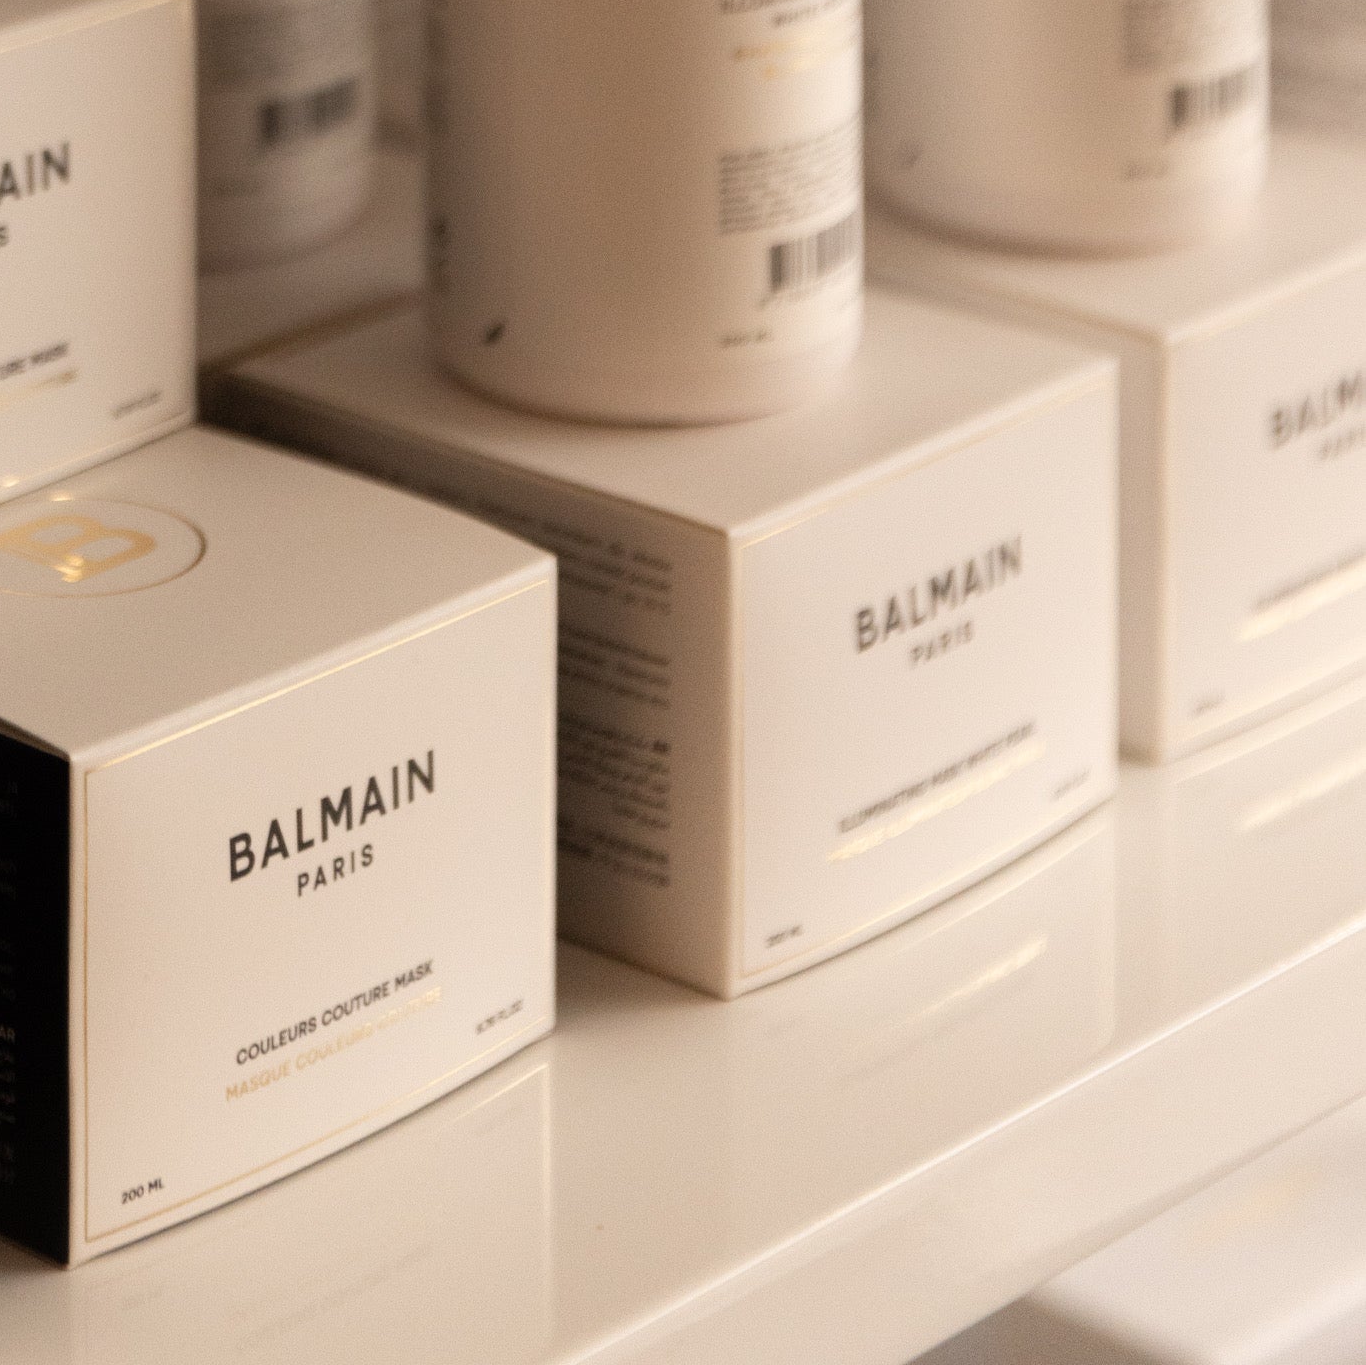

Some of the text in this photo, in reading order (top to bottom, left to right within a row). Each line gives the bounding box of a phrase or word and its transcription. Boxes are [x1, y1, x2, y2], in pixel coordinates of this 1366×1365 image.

[855, 533, 1024, 656] BALMAIN
[229, 749, 435, 883] BALMAIN
[297, 842, 375, 898] PARIS
[235, 958, 435, 1066] COULEURS COUTURE MASK
[225, 1059, 292, 1103] MASQUE
[121, 1177, 165, 1205] 200 ML
